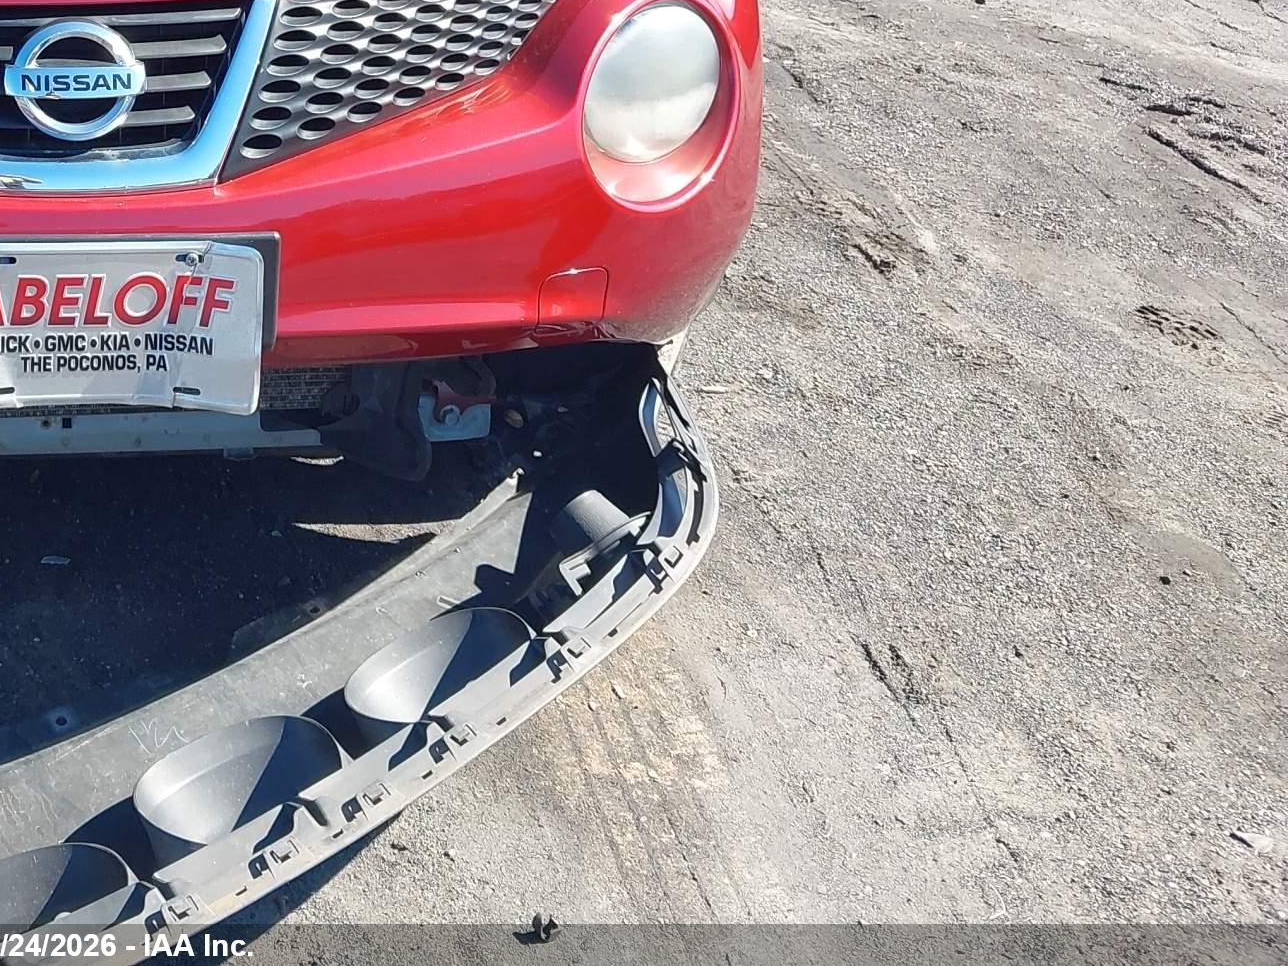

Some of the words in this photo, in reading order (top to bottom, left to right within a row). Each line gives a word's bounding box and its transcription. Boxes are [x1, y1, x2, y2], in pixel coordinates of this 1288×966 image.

[21, 73, 132, 92] NISSAN
[44, 335, 87, 352] GMC
[100, 335, 131, 351] KIA
[144, 334, 213, 356] NISSAN
[21, 356, 52, 373] THE
[56, 354, 142, 374] POCONOS,
[145, 355, 168, 372] PA
